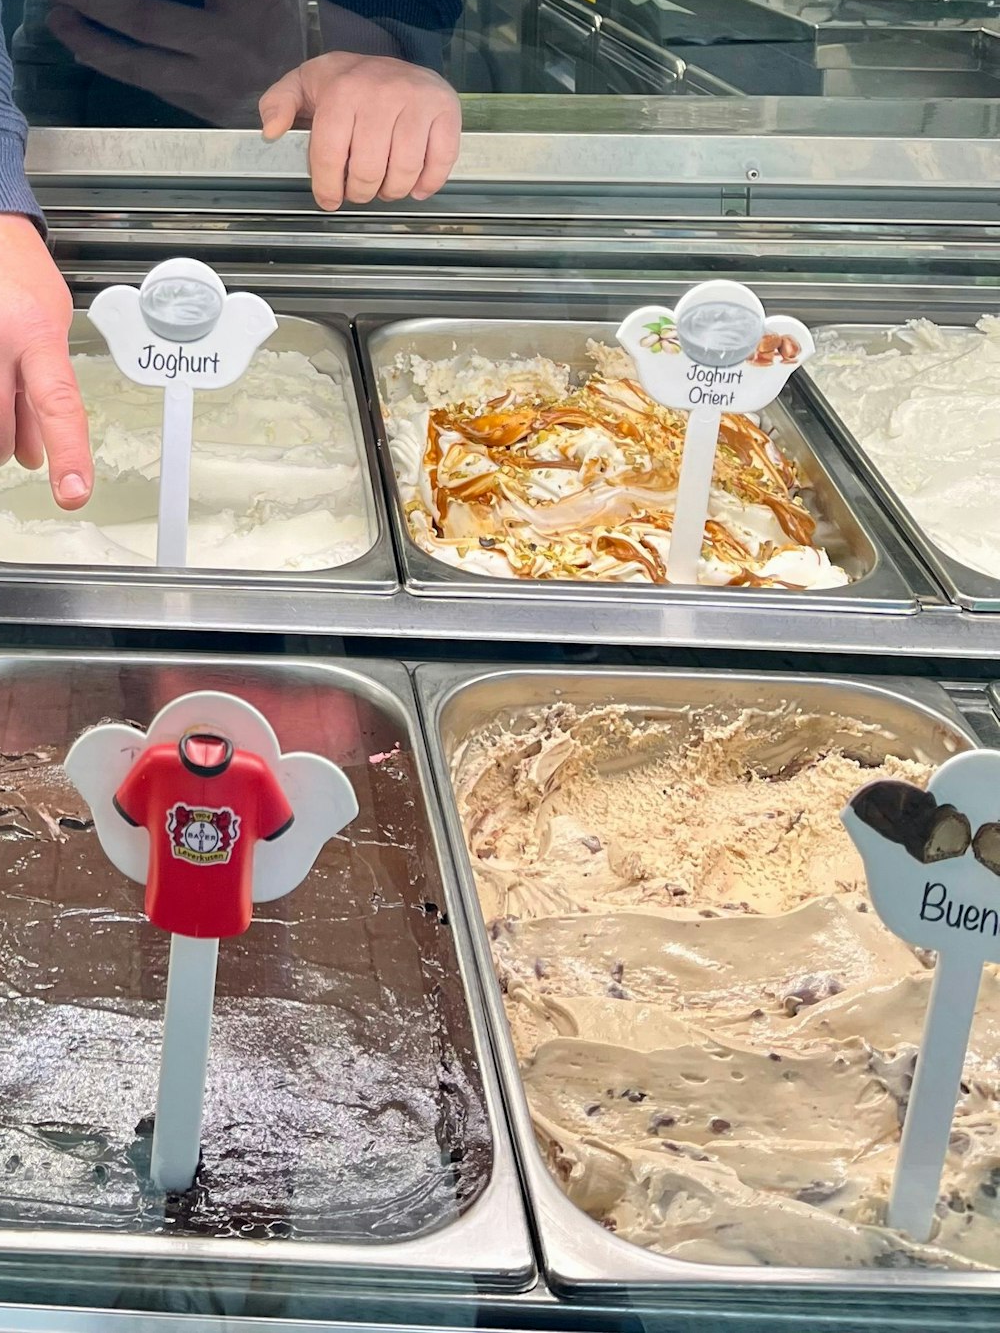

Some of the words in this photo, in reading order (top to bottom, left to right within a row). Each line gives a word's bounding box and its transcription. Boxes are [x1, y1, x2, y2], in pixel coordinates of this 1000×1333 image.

[138, 344, 221, 379] Joghurt
[686, 363, 744, 388] Joghurt
[688, 386, 736, 407] Orient
[187, 832, 216, 841] BAYER
[919, 880, 1000, 937] Buen
